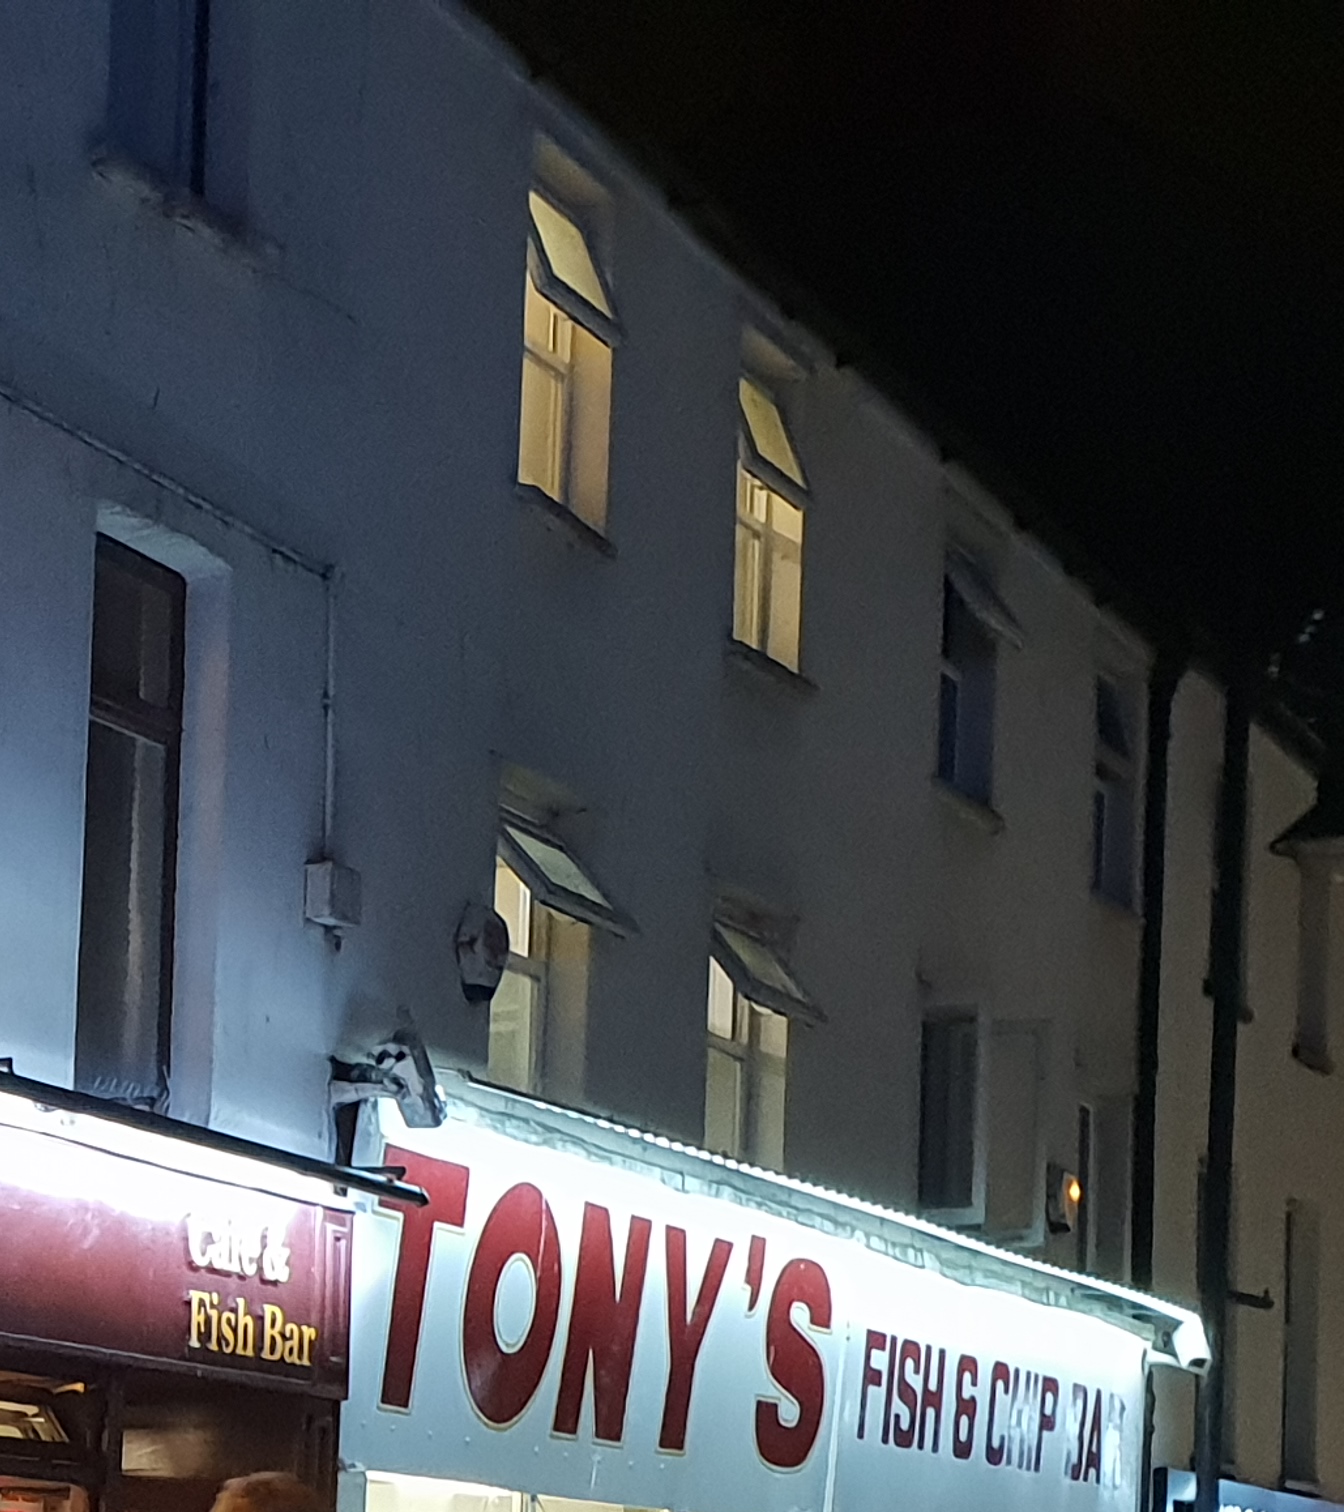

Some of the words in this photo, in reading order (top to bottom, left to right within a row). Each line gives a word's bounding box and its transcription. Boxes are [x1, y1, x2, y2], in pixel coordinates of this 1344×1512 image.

[187, 1289, 255, 1358] Fish
[260, 1303, 318, 1367] Bar
[378, 1142, 833, 1473] TONY'S
[856, 1328, 947, 1454] FISH
